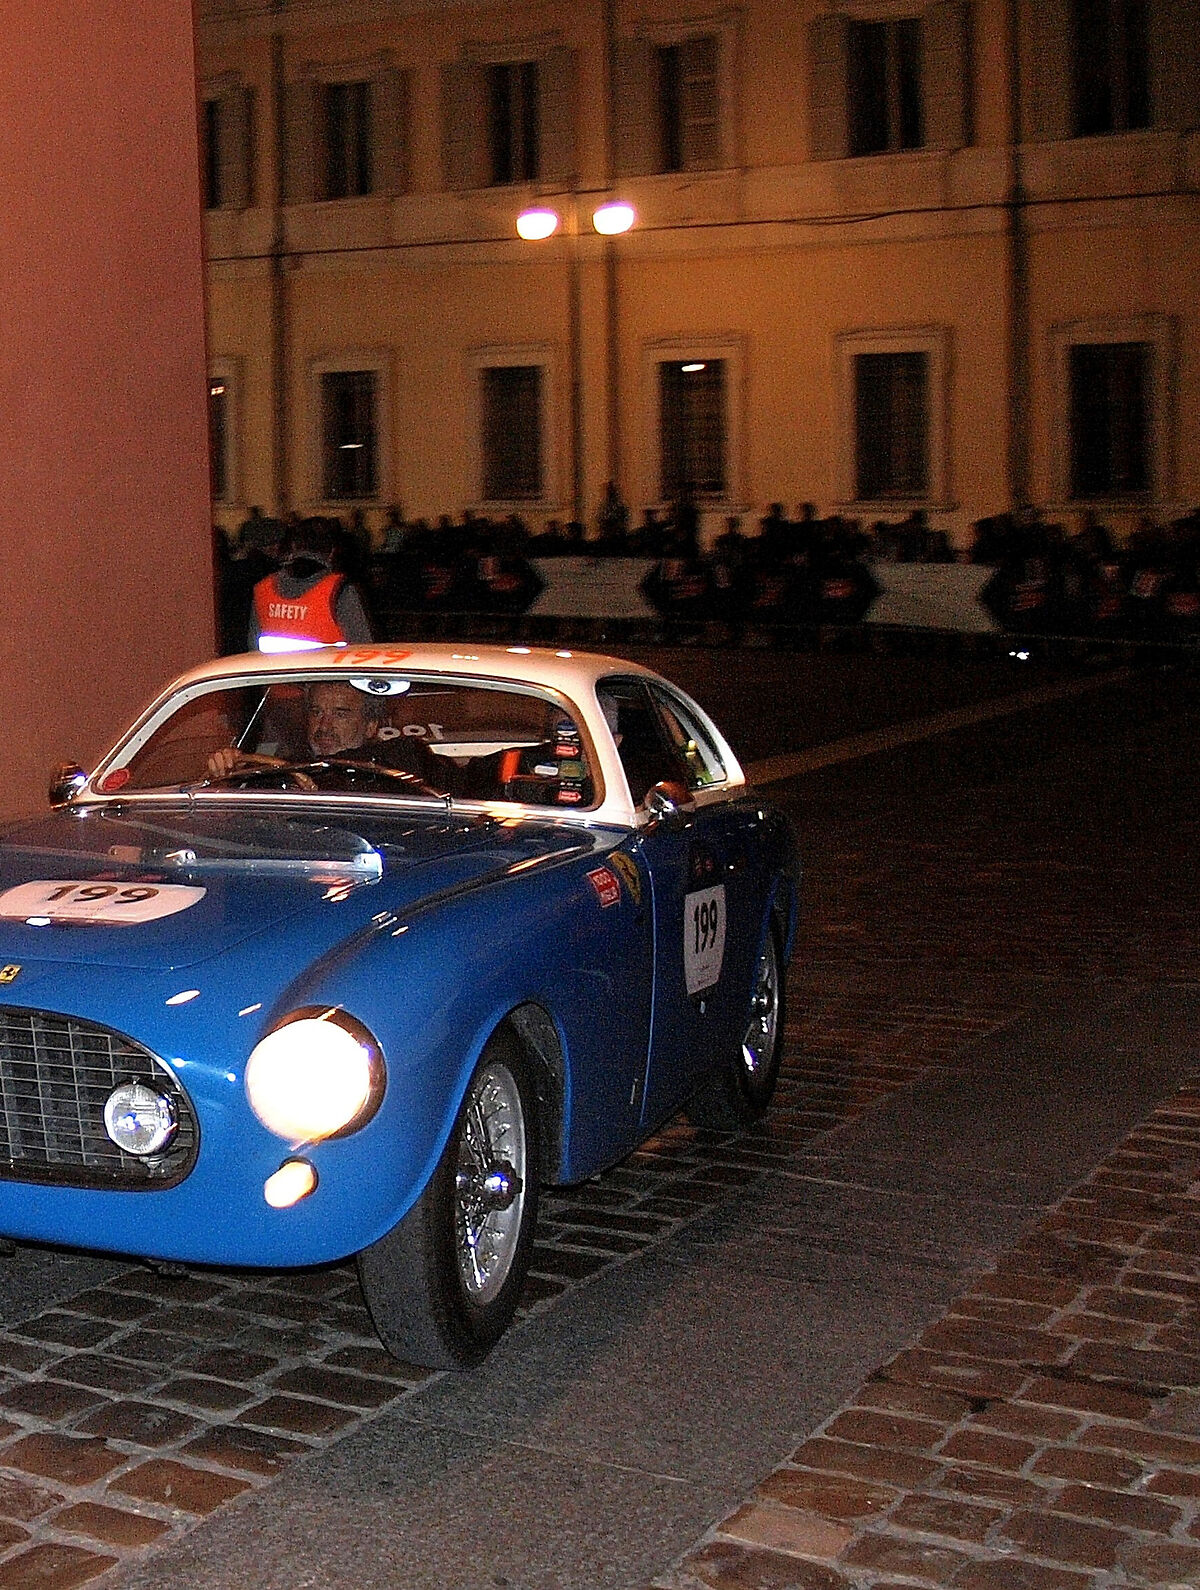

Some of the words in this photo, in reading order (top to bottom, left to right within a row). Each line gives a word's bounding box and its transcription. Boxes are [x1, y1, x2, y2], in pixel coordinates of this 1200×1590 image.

[268, 603, 308, 620] SAFETY
[333, 650, 413, 664] 199
[47, 884, 160, 903] 199
[693, 899, 718, 954] 199
